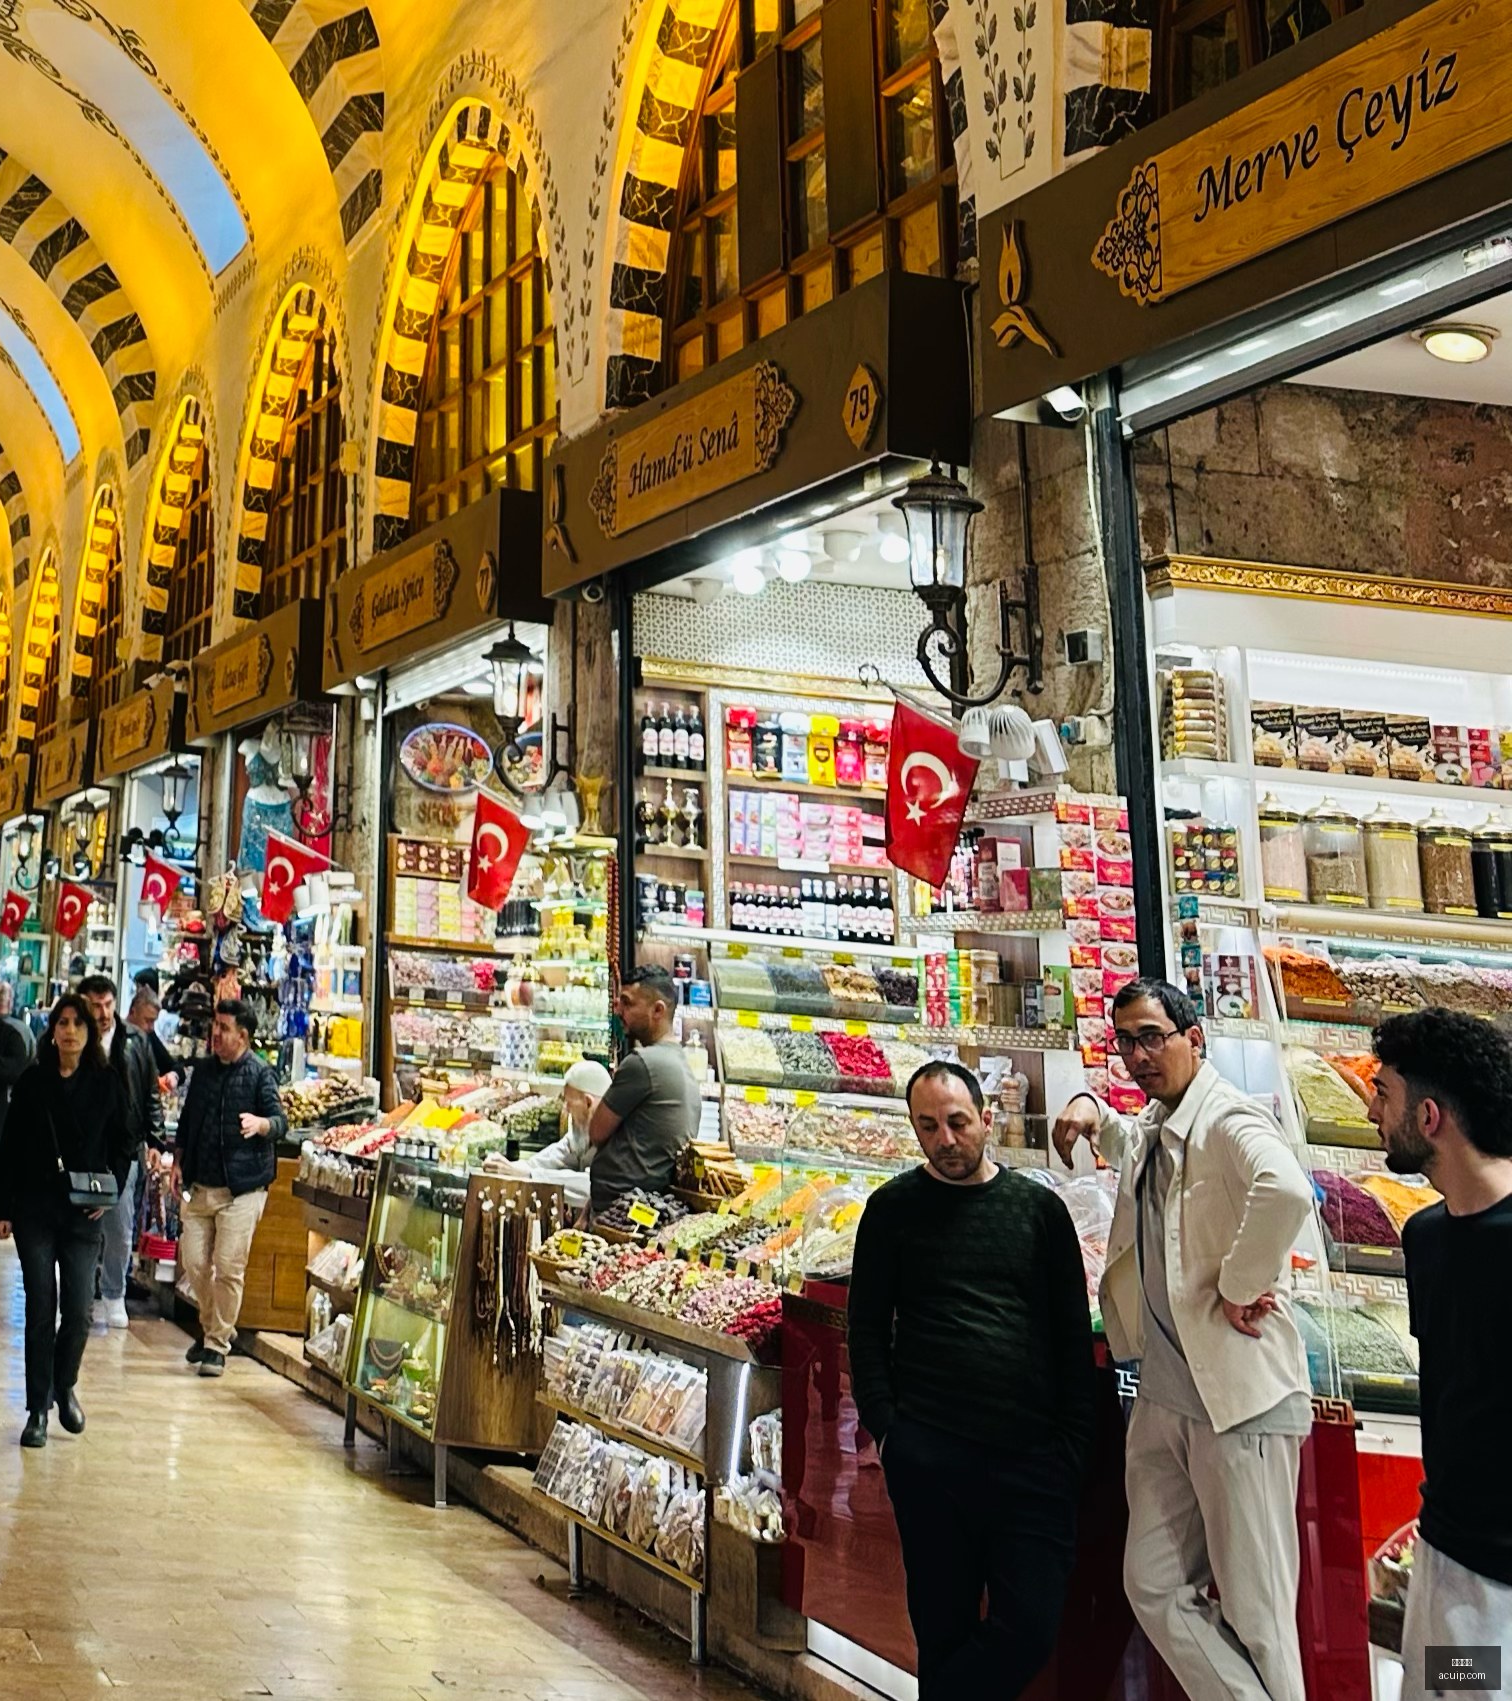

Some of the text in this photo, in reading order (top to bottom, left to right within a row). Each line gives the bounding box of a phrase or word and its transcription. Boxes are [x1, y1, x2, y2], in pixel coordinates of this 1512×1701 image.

[1194, 48, 1459, 223] Merve Çeyiz
[849, 384, 870, 428] 79
[628, 410, 741, 499] Hamd-ü Senâ
[371, 573, 425, 629] Galata Spice
